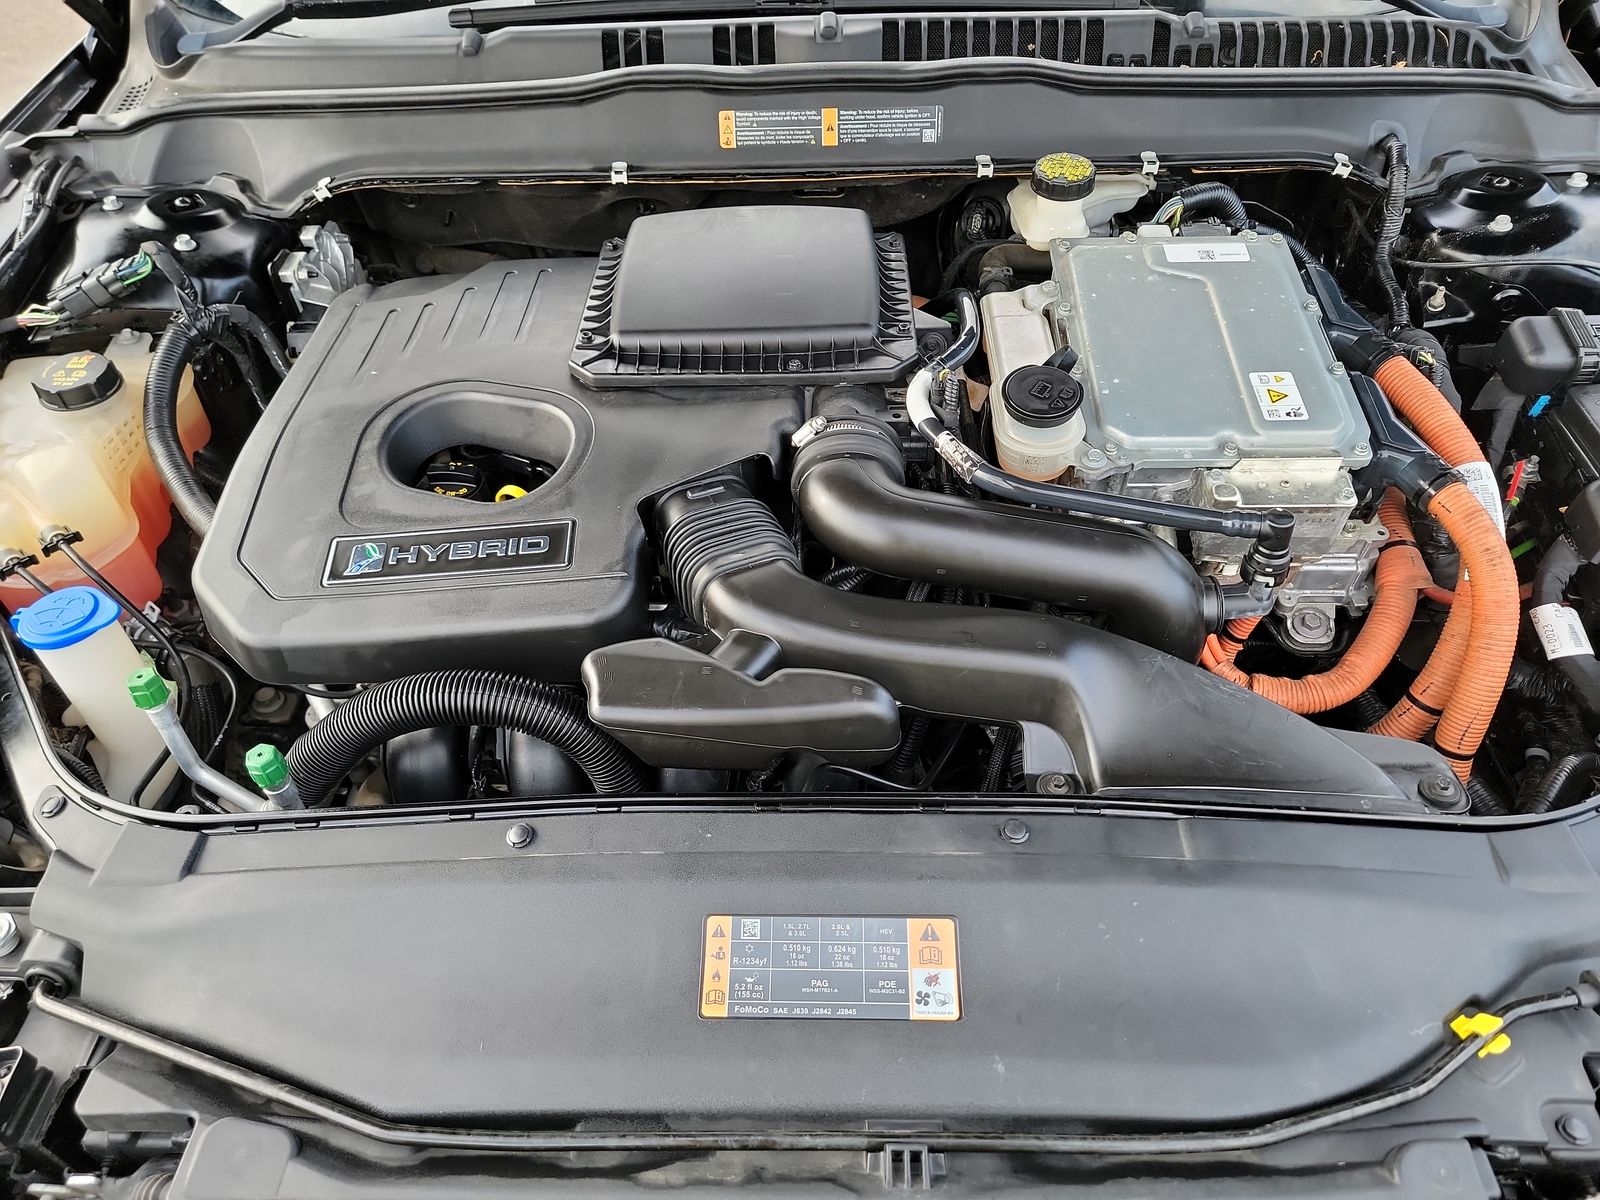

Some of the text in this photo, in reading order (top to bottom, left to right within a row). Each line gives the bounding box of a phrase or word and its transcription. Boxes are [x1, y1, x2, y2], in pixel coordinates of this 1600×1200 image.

[388, 535, 550, 565] HYBRID
[1530, 608, 1541, 624] CAG
[1542, 624, 1561, 654] M-0023
[802, 944, 812, 953] kg
[847, 945, 856, 954] kg
[892, 946, 901, 954] kg
[732, 957, 768, 968] R-1234yf
[734, 990, 764, 999] (155 cc)
[734, 1005, 769, 1014] FoMoCo
